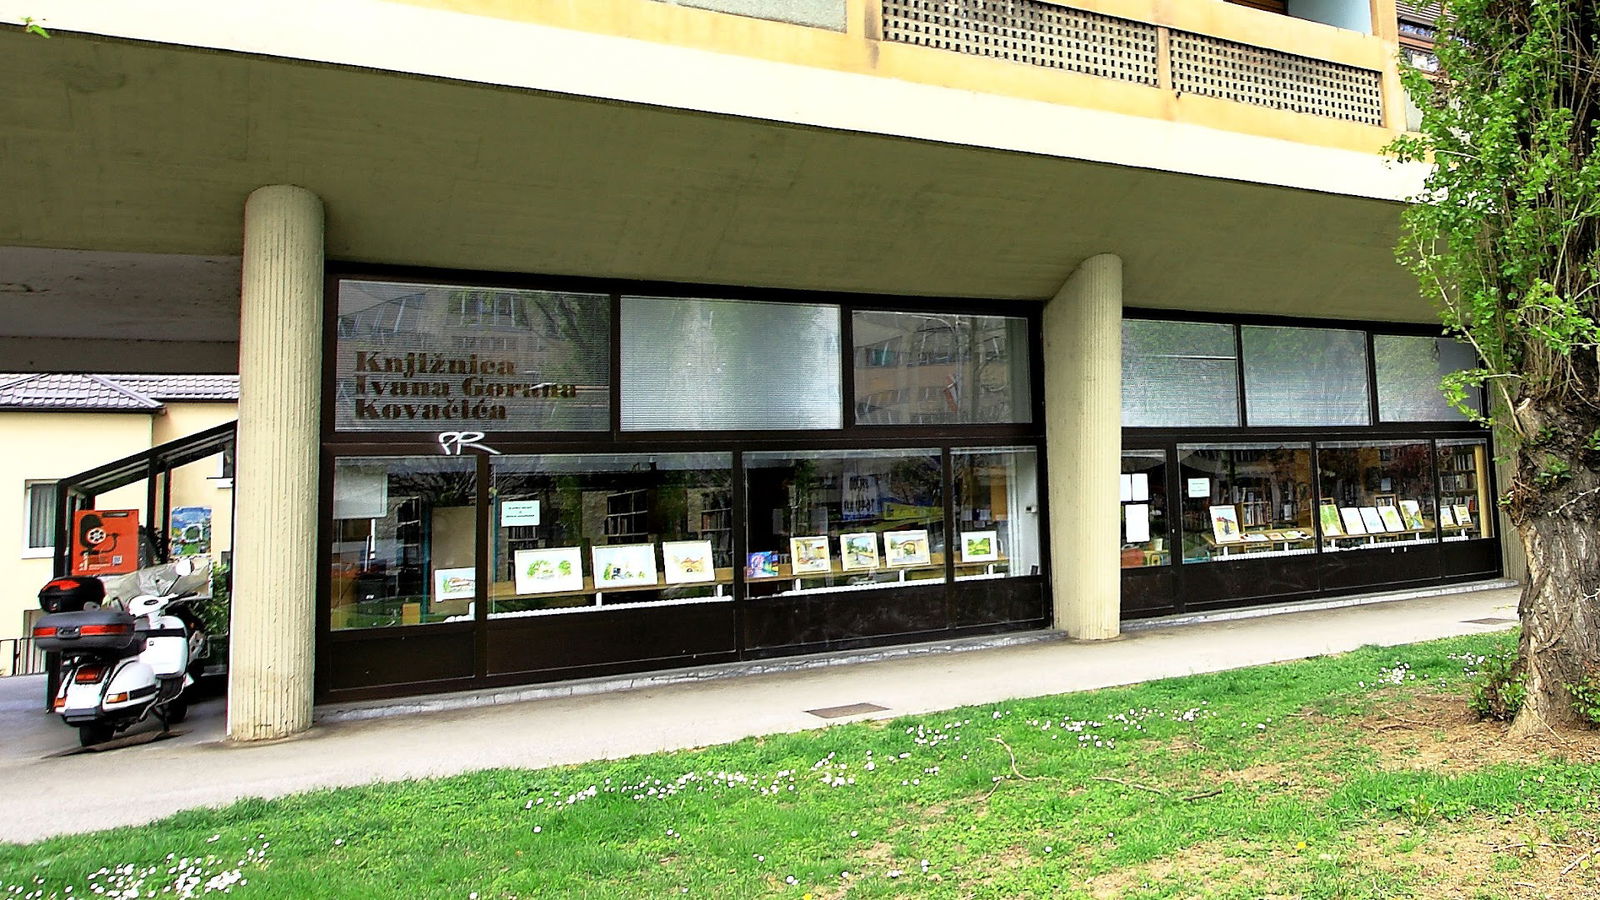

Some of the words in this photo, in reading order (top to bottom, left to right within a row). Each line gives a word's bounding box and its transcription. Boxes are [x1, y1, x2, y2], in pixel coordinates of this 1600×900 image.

[356, 351, 516, 377] Knjižnica
[356, 375, 450, 397] Ivana
[461, 376, 578, 398] Gorana
[355, 398, 506, 420] Kovačića
